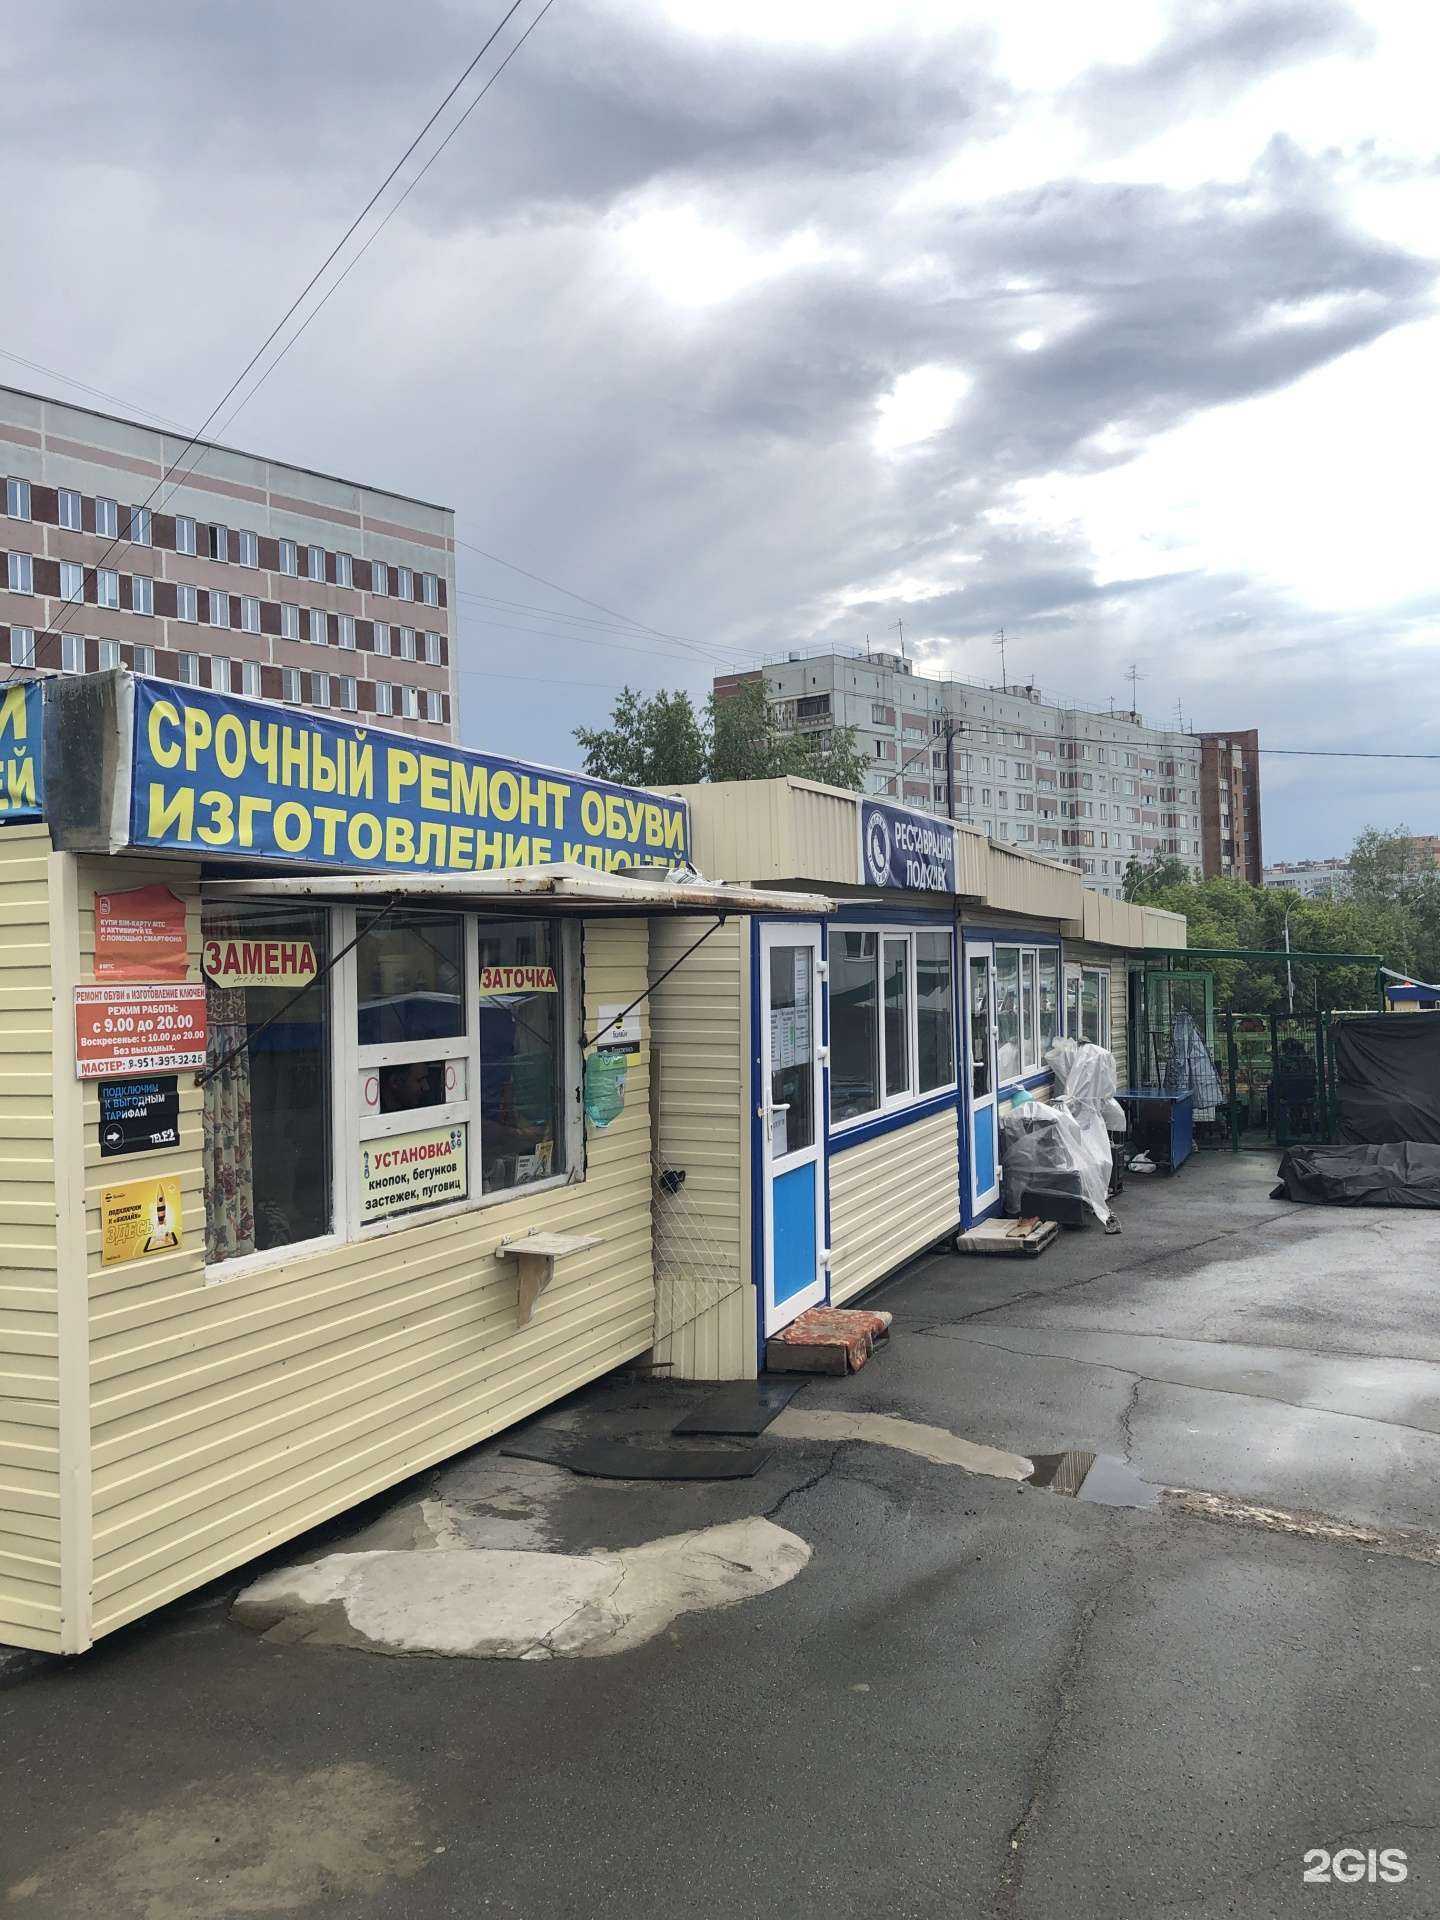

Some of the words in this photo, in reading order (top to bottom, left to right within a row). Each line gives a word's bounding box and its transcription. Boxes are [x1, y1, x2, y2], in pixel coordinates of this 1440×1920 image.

[148, 700, 374, 800] СРОЧНЫЙ
[387, 747, 571, 830] РЕМОНТ
[581, 790, 685, 851] ОБУВИ
[147, 783, 552, 870] ИЗГОТОВЛЕНИЕ
[894, 821, 952, 861] РЕСТАВРАЦИЯ
[206, 941, 315, 975] ЗАМЕНА
[482, 968, 555, 988] ЗАТОЧКА
[76, 991, 103, 1001] РЕМОНТ
[103, 990, 125, 1000] ОБУВИ
[131, 988, 178, 999] ИЗГОТОВЛЕНИЕ
[108, 1006, 140, 1015] РЕЖИМ
[142, 1004, 179, 1014] РАБОТЫ:
[92, 1022, 101, 1033] с
[104, 1017, 134, 1032] 9.00
[137, 1020, 154, 1032] до
[157, 1014, 193, 1030] 20.00
[81, 1035, 140, 1047] Воскресенье:
[148, 1032, 170, 1042] 10.00
[183, 1030, 205, 1040] 20.00
[113, 1046, 130, 1055] Без
[131, 1044, 176, 1054] выходных.
[81, 1060, 126, 1074] МАСТЕР:
[104, 1099, 111, 1109] К
[113, 1094, 165, 1108] ВЫГОДНЫМ
[105, 1107, 148, 1121] ТАРИФАМ
[149, 1128, 176, 1143] TELE2
[374, 1140, 452, 1170] УСТАНОВКА
[368, 1173, 410, 1190] кнопок,
[412, 1163, 457, 1180] бегунков
[365, 1189, 420, 1210] застежек,
[422, 1179, 461, 1198] пуговиц
[106, 1218, 154, 1246] ЗДЕСЬ
